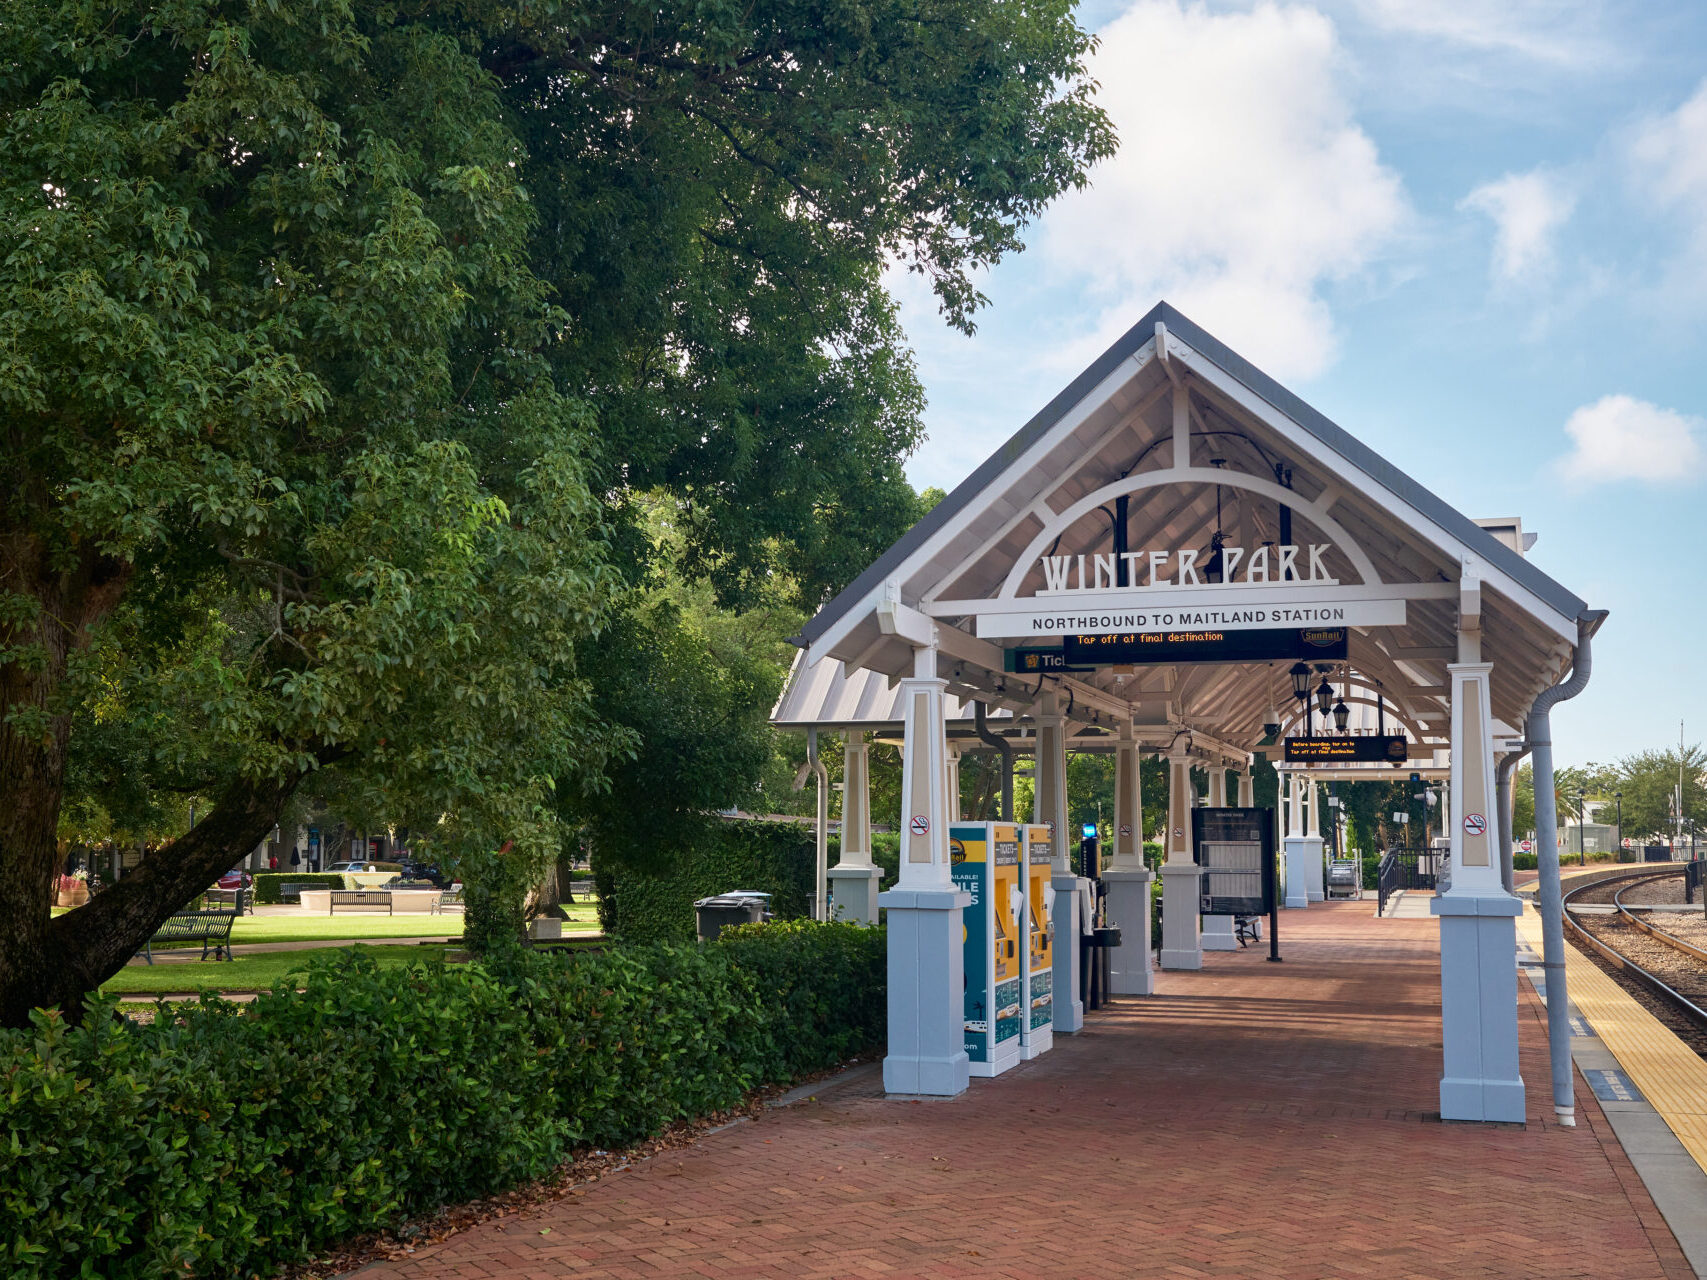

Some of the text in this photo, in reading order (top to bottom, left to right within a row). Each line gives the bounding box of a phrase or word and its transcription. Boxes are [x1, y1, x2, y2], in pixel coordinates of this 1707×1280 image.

[1042, 544, 1332, 590] WINTER PARK
[1033, 608, 1344, 629] NORTHBOUND TO MAITLAND STATION
[1077, 632, 1223, 645] Tap off at final destination
[1306, 631, 1340, 640] SunRail
